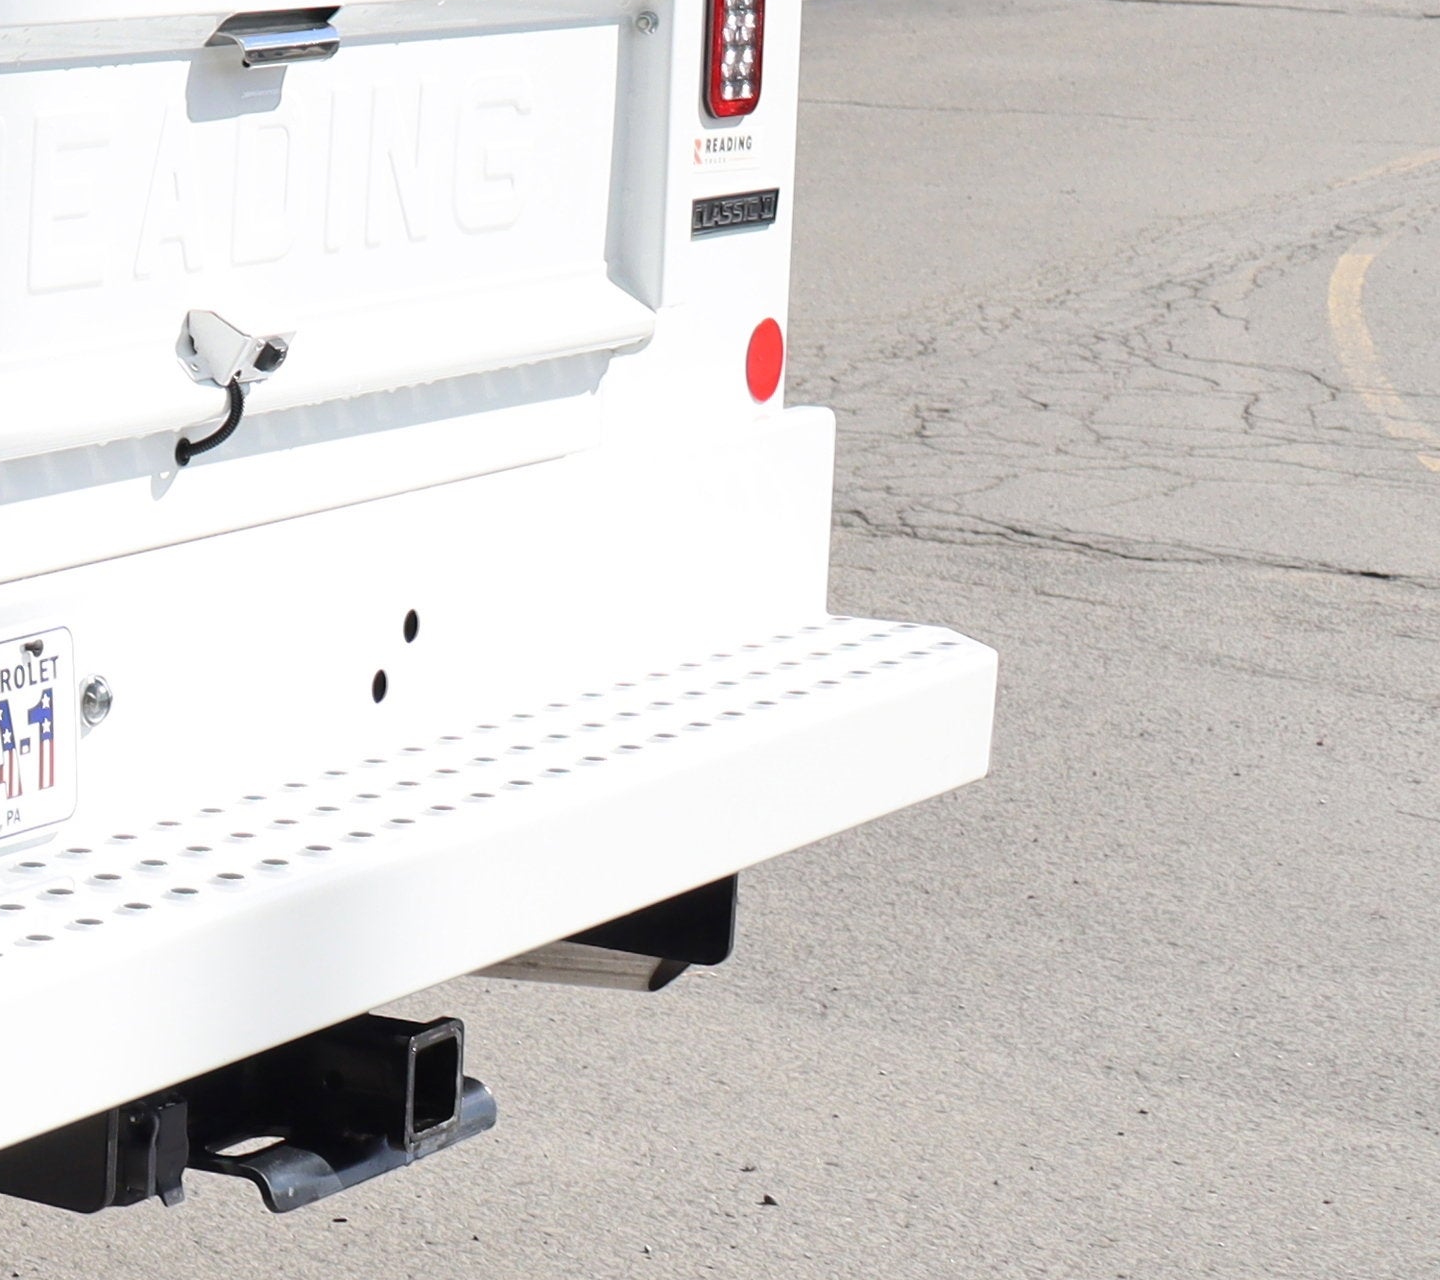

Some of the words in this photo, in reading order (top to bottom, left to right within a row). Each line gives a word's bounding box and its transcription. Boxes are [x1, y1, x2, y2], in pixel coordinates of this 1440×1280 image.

[705, 135, 752, 153] READING
[693, 196, 760, 229] CLASSIC
[6, 808, 22, 826] PA
